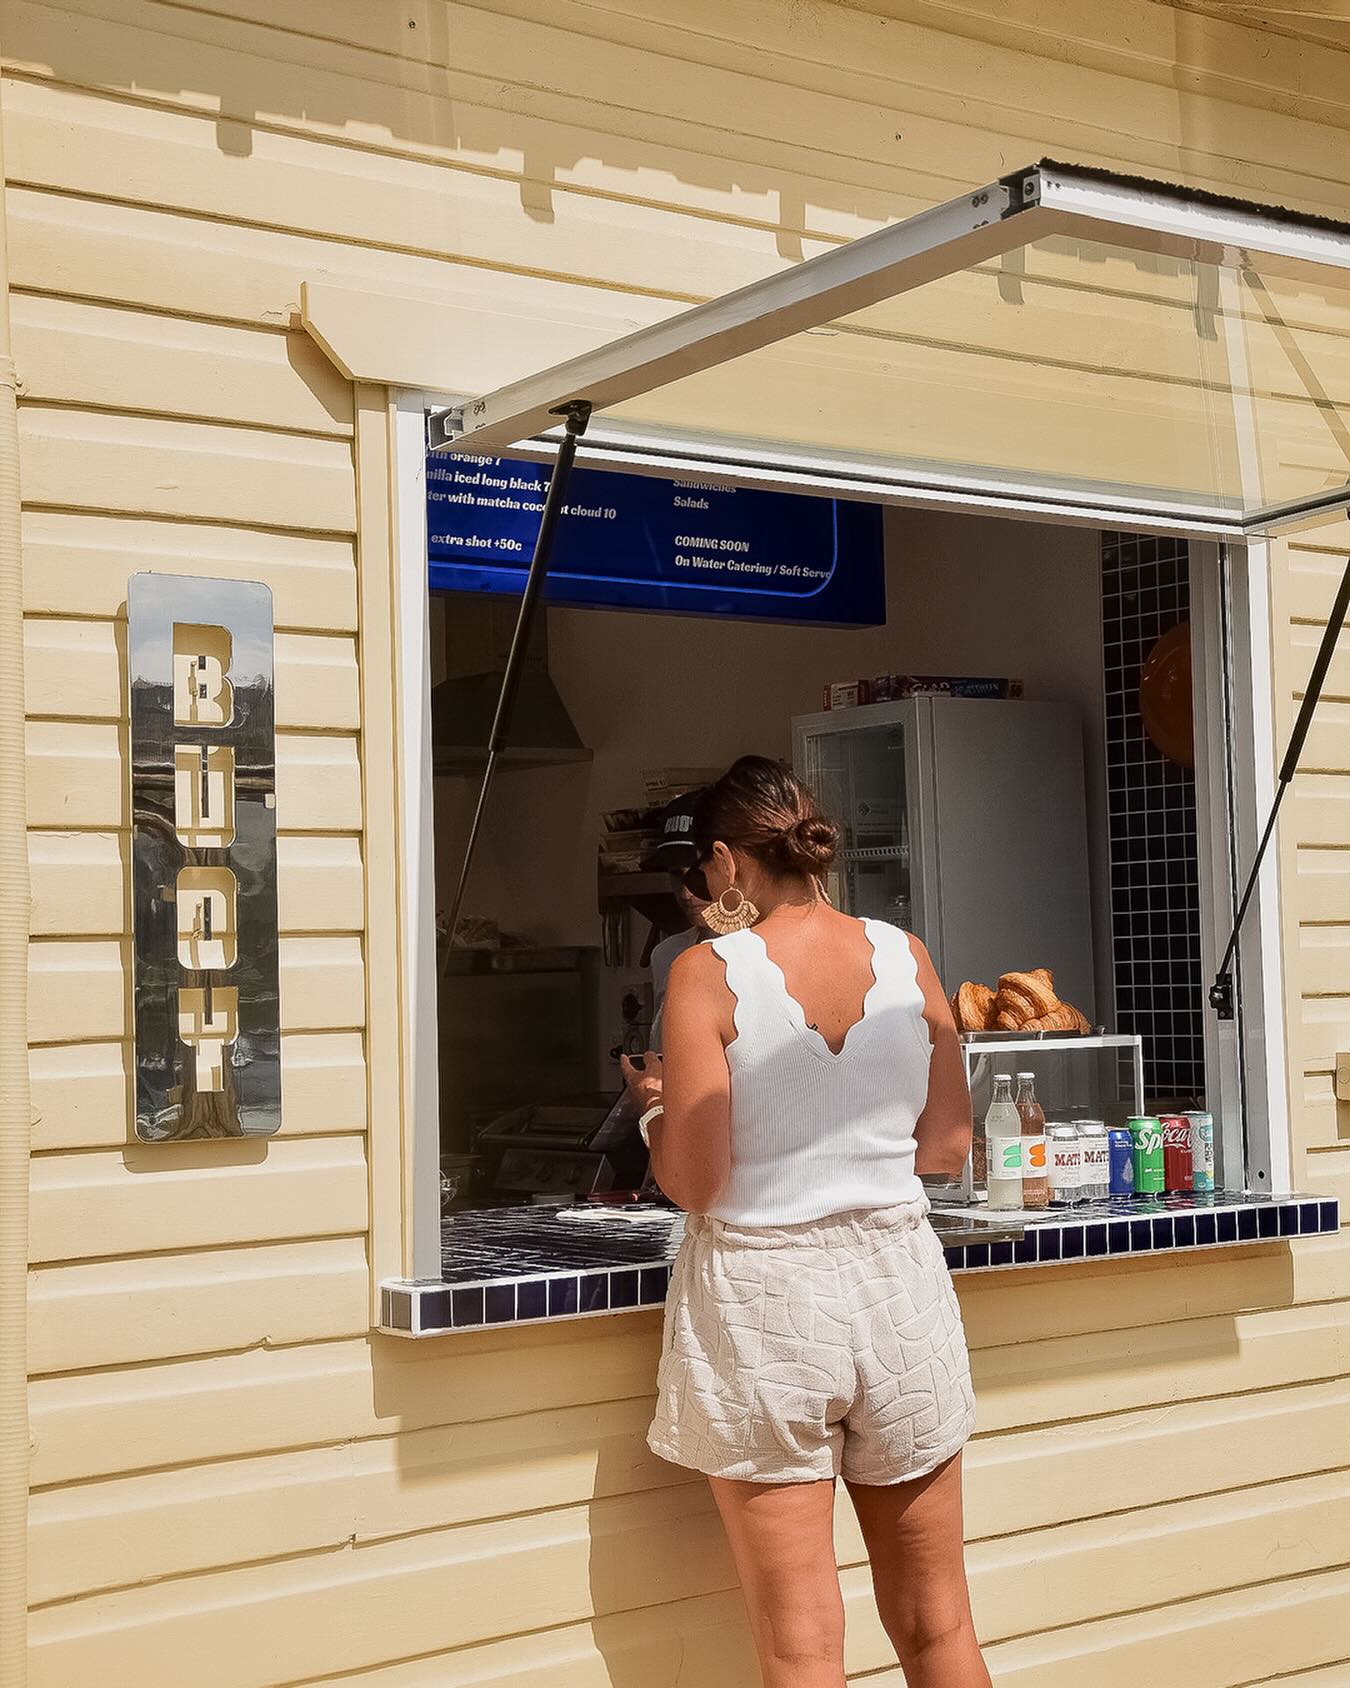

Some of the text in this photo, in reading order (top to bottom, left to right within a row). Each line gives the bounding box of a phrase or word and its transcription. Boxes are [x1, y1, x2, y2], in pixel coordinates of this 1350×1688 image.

[450, 453, 493, 466] orange
[454, 471, 480, 485] iced
[481, 474, 508, 490] long
[510, 477, 542, 492] black
[544, 482, 552, 492] 7
[448, 492, 475, 506] with
[476, 495, 520, 510] matcha
[571, 506, 602, 518] cloud
[603, 508, 617, 520] 10
[674, 496, 709, 510] Salads
[431, 532, 522, 551] extra shot +50c
[674, 536, 750, 552] COMING SOON
[675, 555, 690, 568] On
[692, 556, 726, 570] Water
[727, 560, 772, 576] Catering
[773, 564, 778, 574] /
[780, 564, 801, 578] Soft
